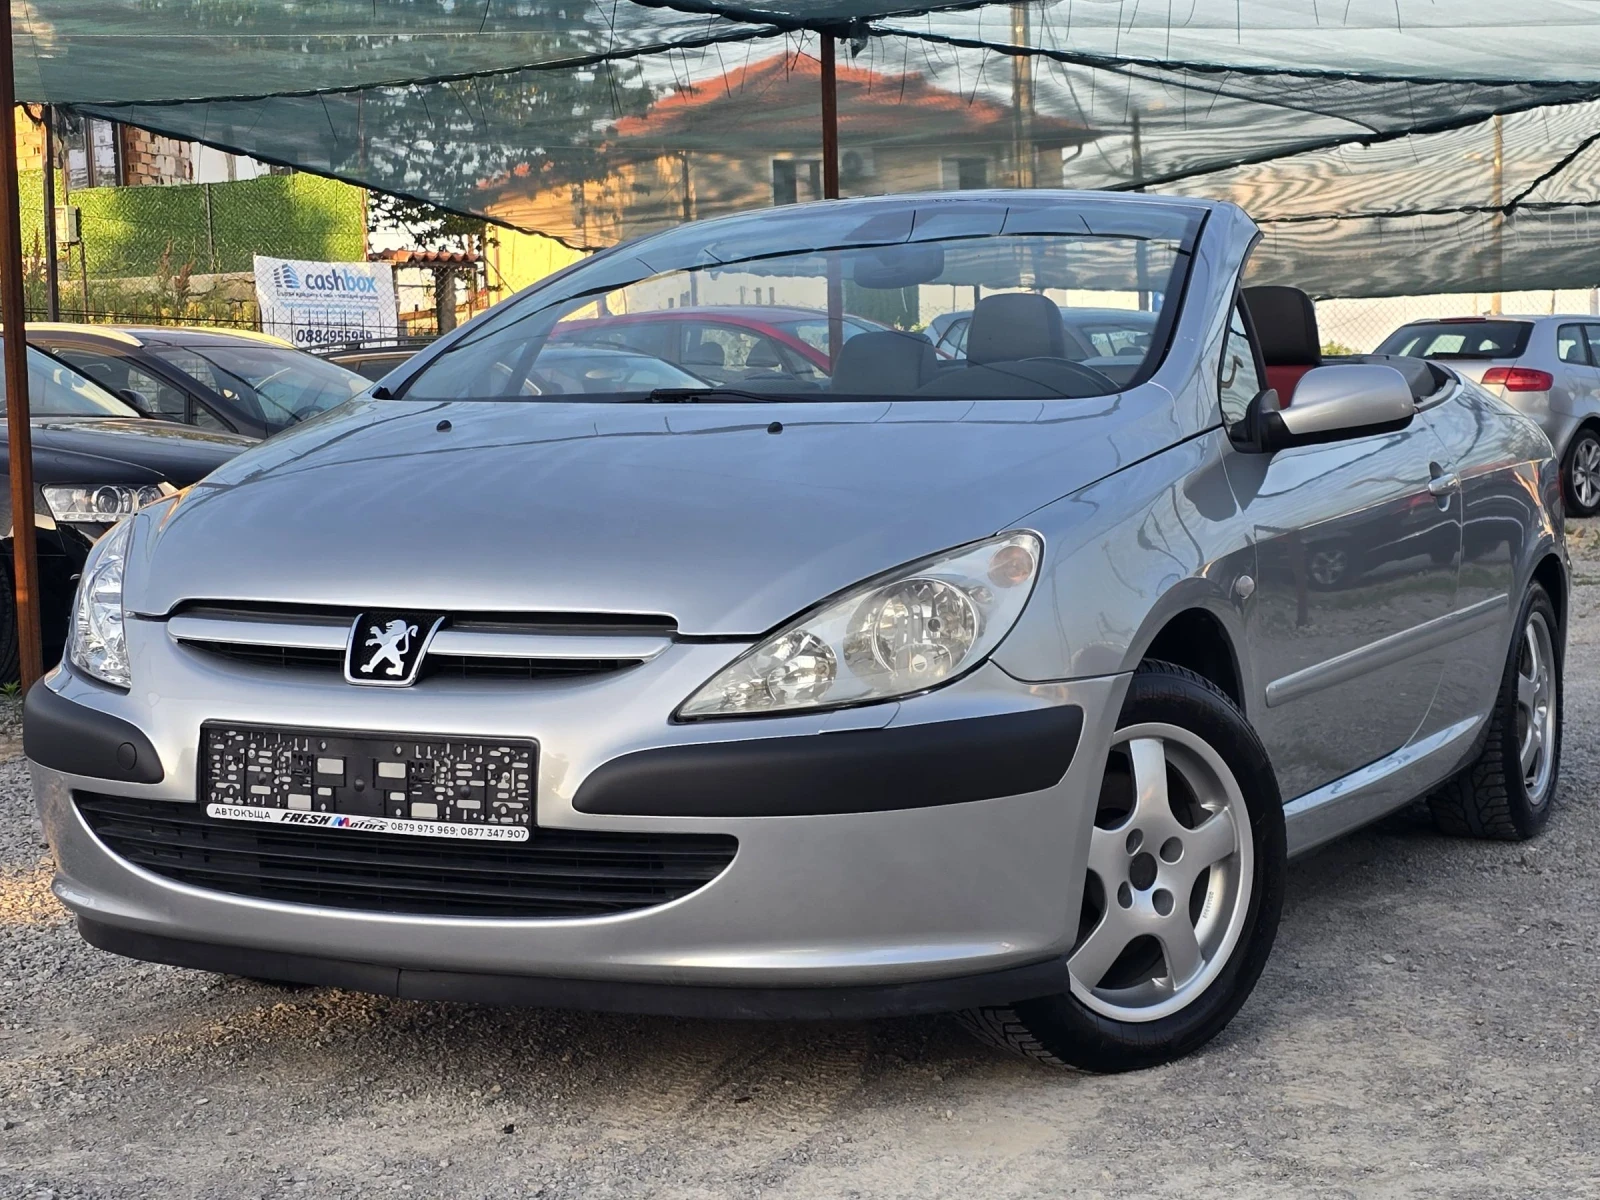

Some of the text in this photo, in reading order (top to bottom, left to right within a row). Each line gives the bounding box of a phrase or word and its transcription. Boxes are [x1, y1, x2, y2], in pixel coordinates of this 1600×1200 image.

[305, 268, 377, 293] cashbox
[214, 807, 271, 820] АВТОКЪЩА
[280, 812, 387, 831] FRESH Motors
[391, 822, 526, 839] 0879 975 969; 0877 347 907
